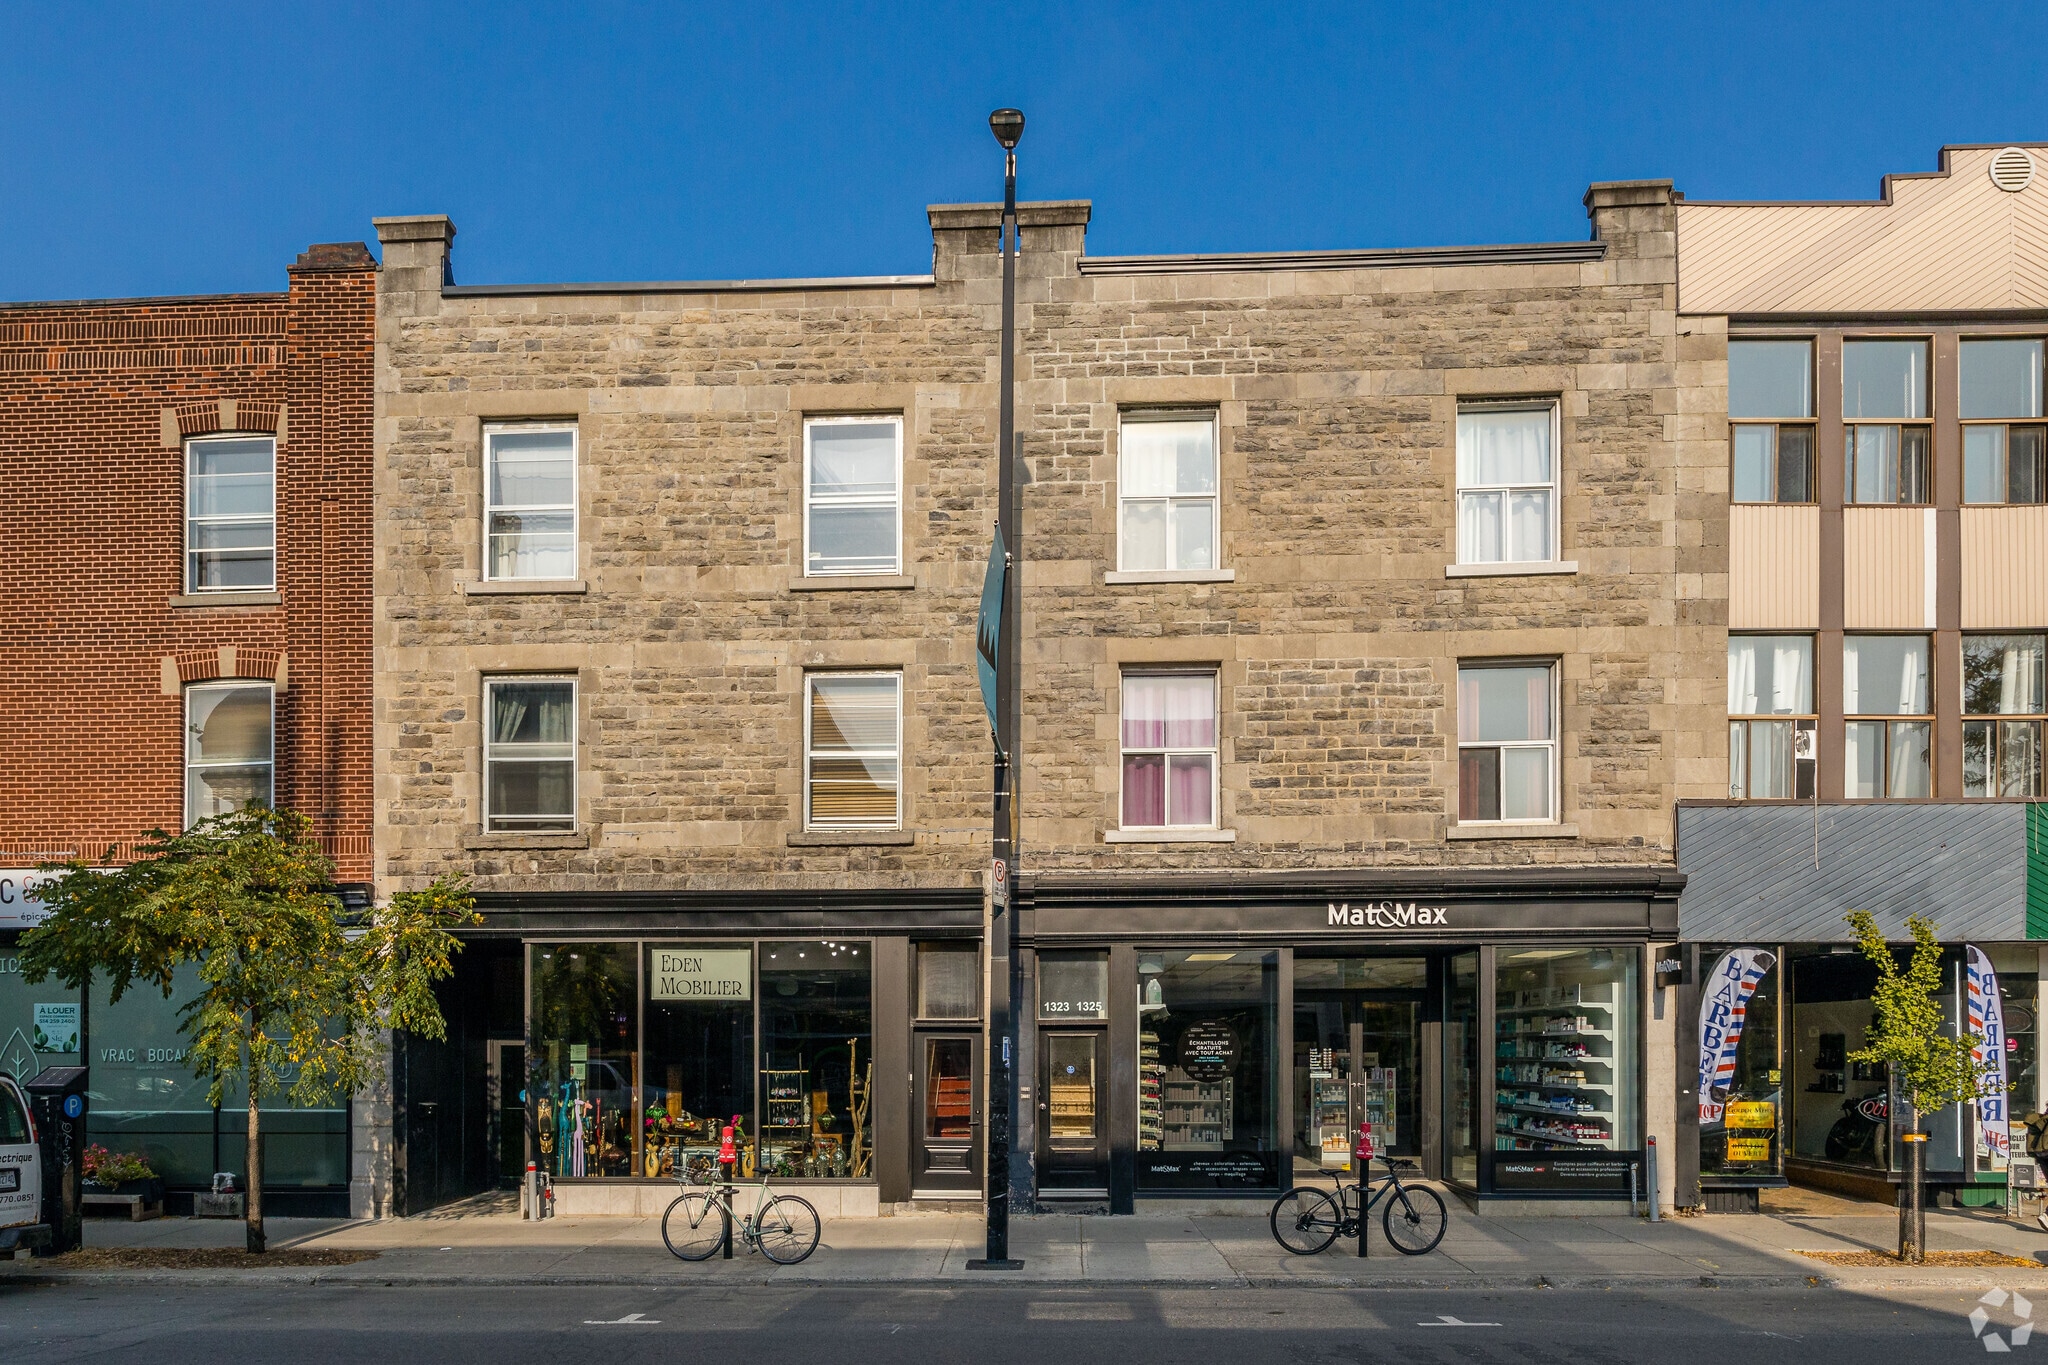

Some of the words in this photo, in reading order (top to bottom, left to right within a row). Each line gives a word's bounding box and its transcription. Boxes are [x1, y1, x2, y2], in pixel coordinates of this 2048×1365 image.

[1328, 901, 1448, 927] Mat&Max
[660, 977, 742, 995] MOBILIER
[39, 1005, 46, 1014] À
[1044, 1001, 1070, 1012] 1323
[1076, 1001, 1103, 1012] 1325
[100, 1048, 135, 1062] VRAC
